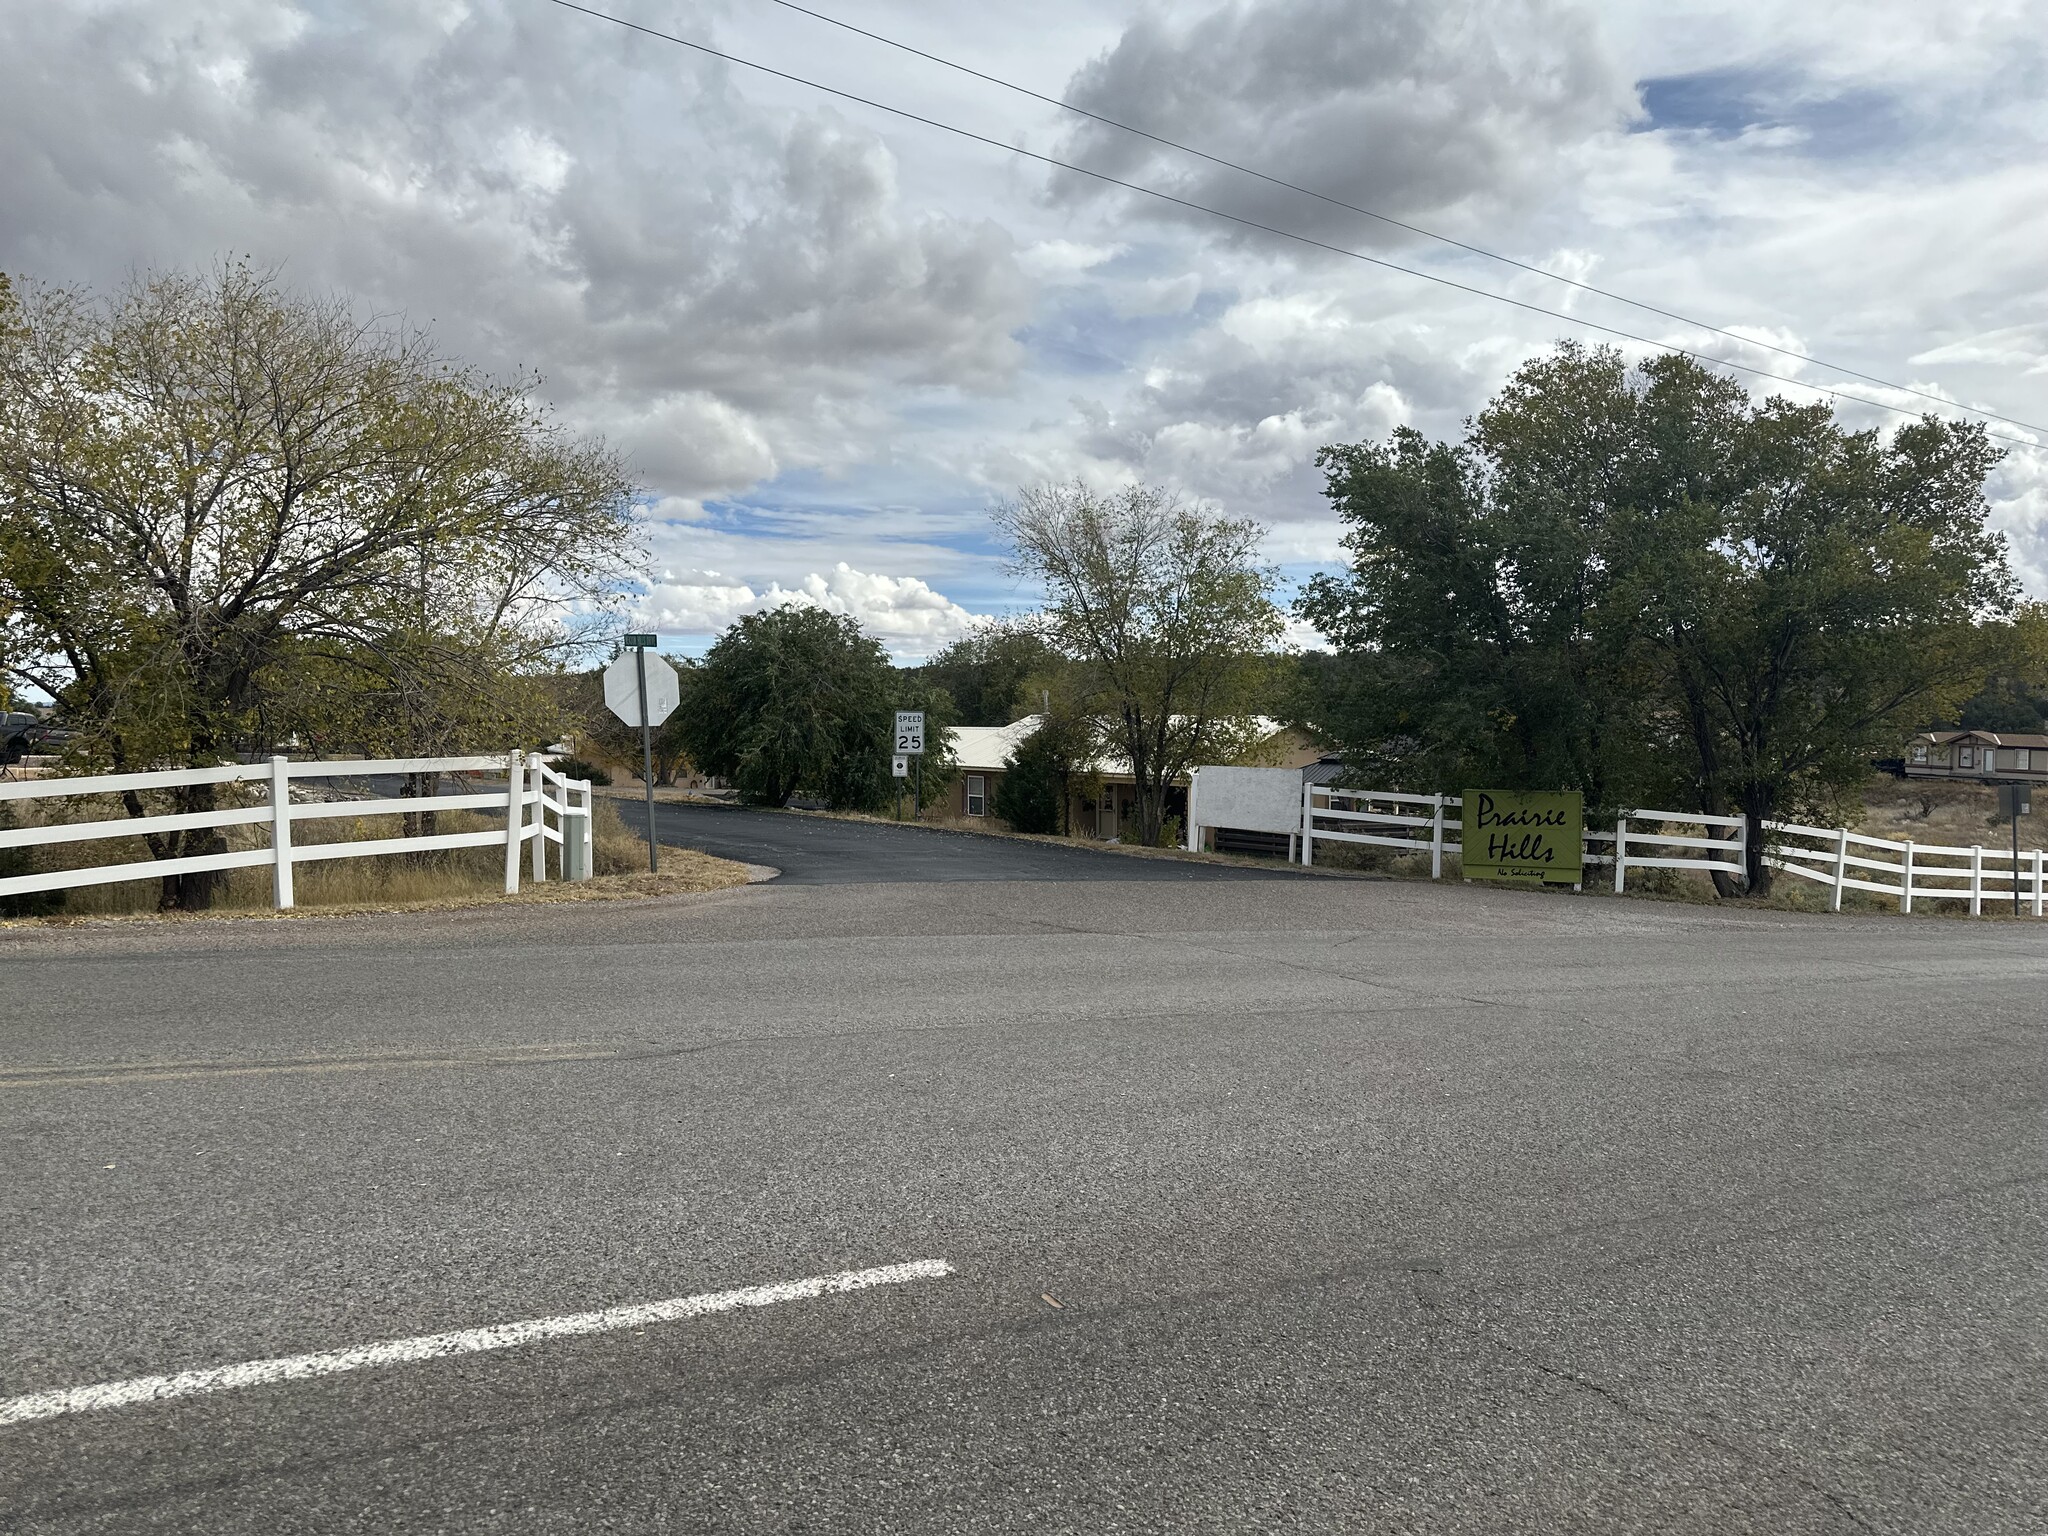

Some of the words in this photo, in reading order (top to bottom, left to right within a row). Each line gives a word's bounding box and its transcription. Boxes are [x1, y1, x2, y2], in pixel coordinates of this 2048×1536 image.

[898, 715, 922, 723] SPEED
[898, 736, 921, 749] 25
[1477, 793, 1566, 829] Prairie
[1488, 833, 1554, 863] Hills
[1497, 868, 1507, 876] No
